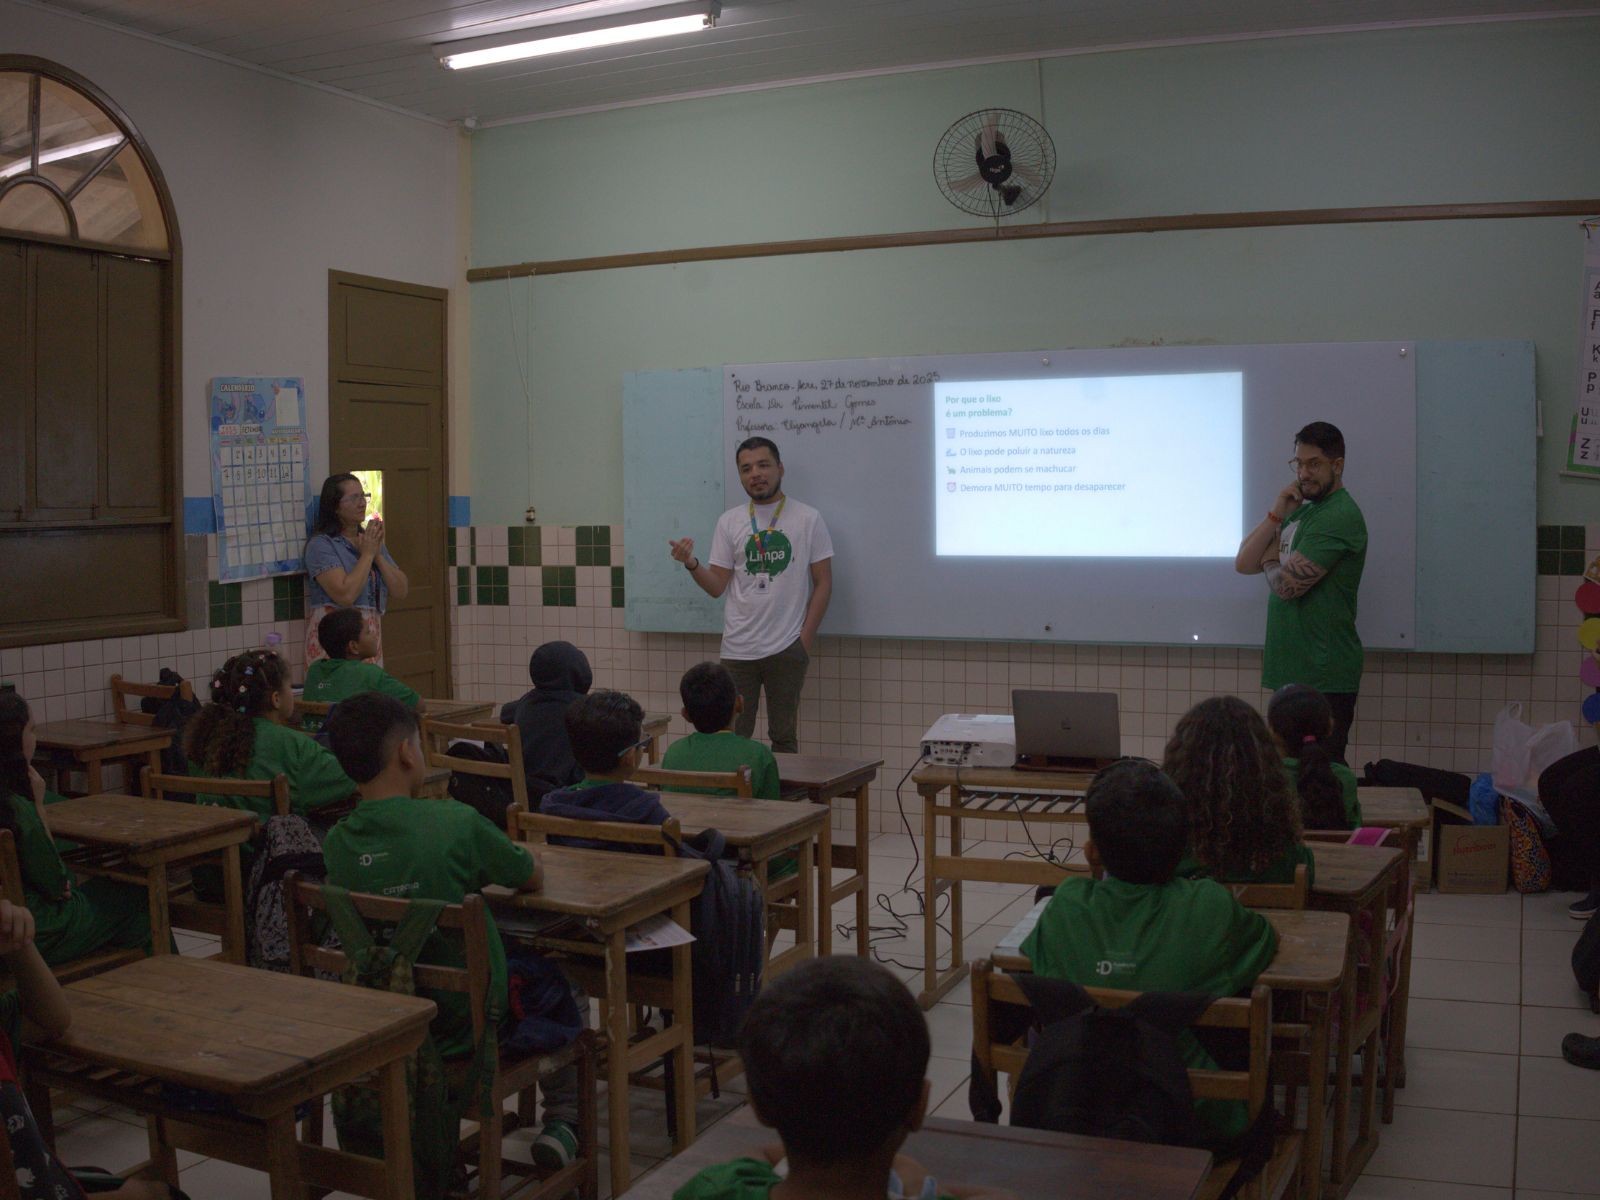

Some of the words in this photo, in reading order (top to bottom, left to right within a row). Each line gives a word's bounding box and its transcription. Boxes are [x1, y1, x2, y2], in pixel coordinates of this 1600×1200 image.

[820, 380, 833, 390] 27
[897, 374, 909, 385] de
[913, 371, 940, 385] 2025
[1588, 372, 1597, 382] P
[945, 395, 959, 404] Por
[961, 396, 977, 405] que
[986, 394, 1001, 403] lixo
[945, 408, 951, 417] é
[968, 407, 1013, 418] problema?
[1581, 407, 1589, 416] U
[959, 429, 1007, 438] Produzimos
[1008, 428, 1038, 437] MUITO
[1040, 428, 1054, 436] lixo
[1056, 427, 1079, 436] todos
[1081, 428, 1091, 436] os
[1093, 427, 1110, 435] dias
[1581, 438, 1590, 449] Z
[960, 447, 966, 455] O
[968, 447, 982, 455] lixo
[984, 447, 1005, 457] pode
[1007, 447, 1030, 456] poluir
[1040, 447, 1076, 455] natureza
[960, 465, 992, 473] Animais
[994, 465, 1023, 474] podem
[1035, 464, 1076, 473] machucar
[960, 483, 992, 492] Demora
[994, 483, 1023, 492] MUITO
[1024, 483, 1052, 493] tempo
[1054, 484, 1072, 492] para
[1074, 482, 1126, 492] desaparecer
